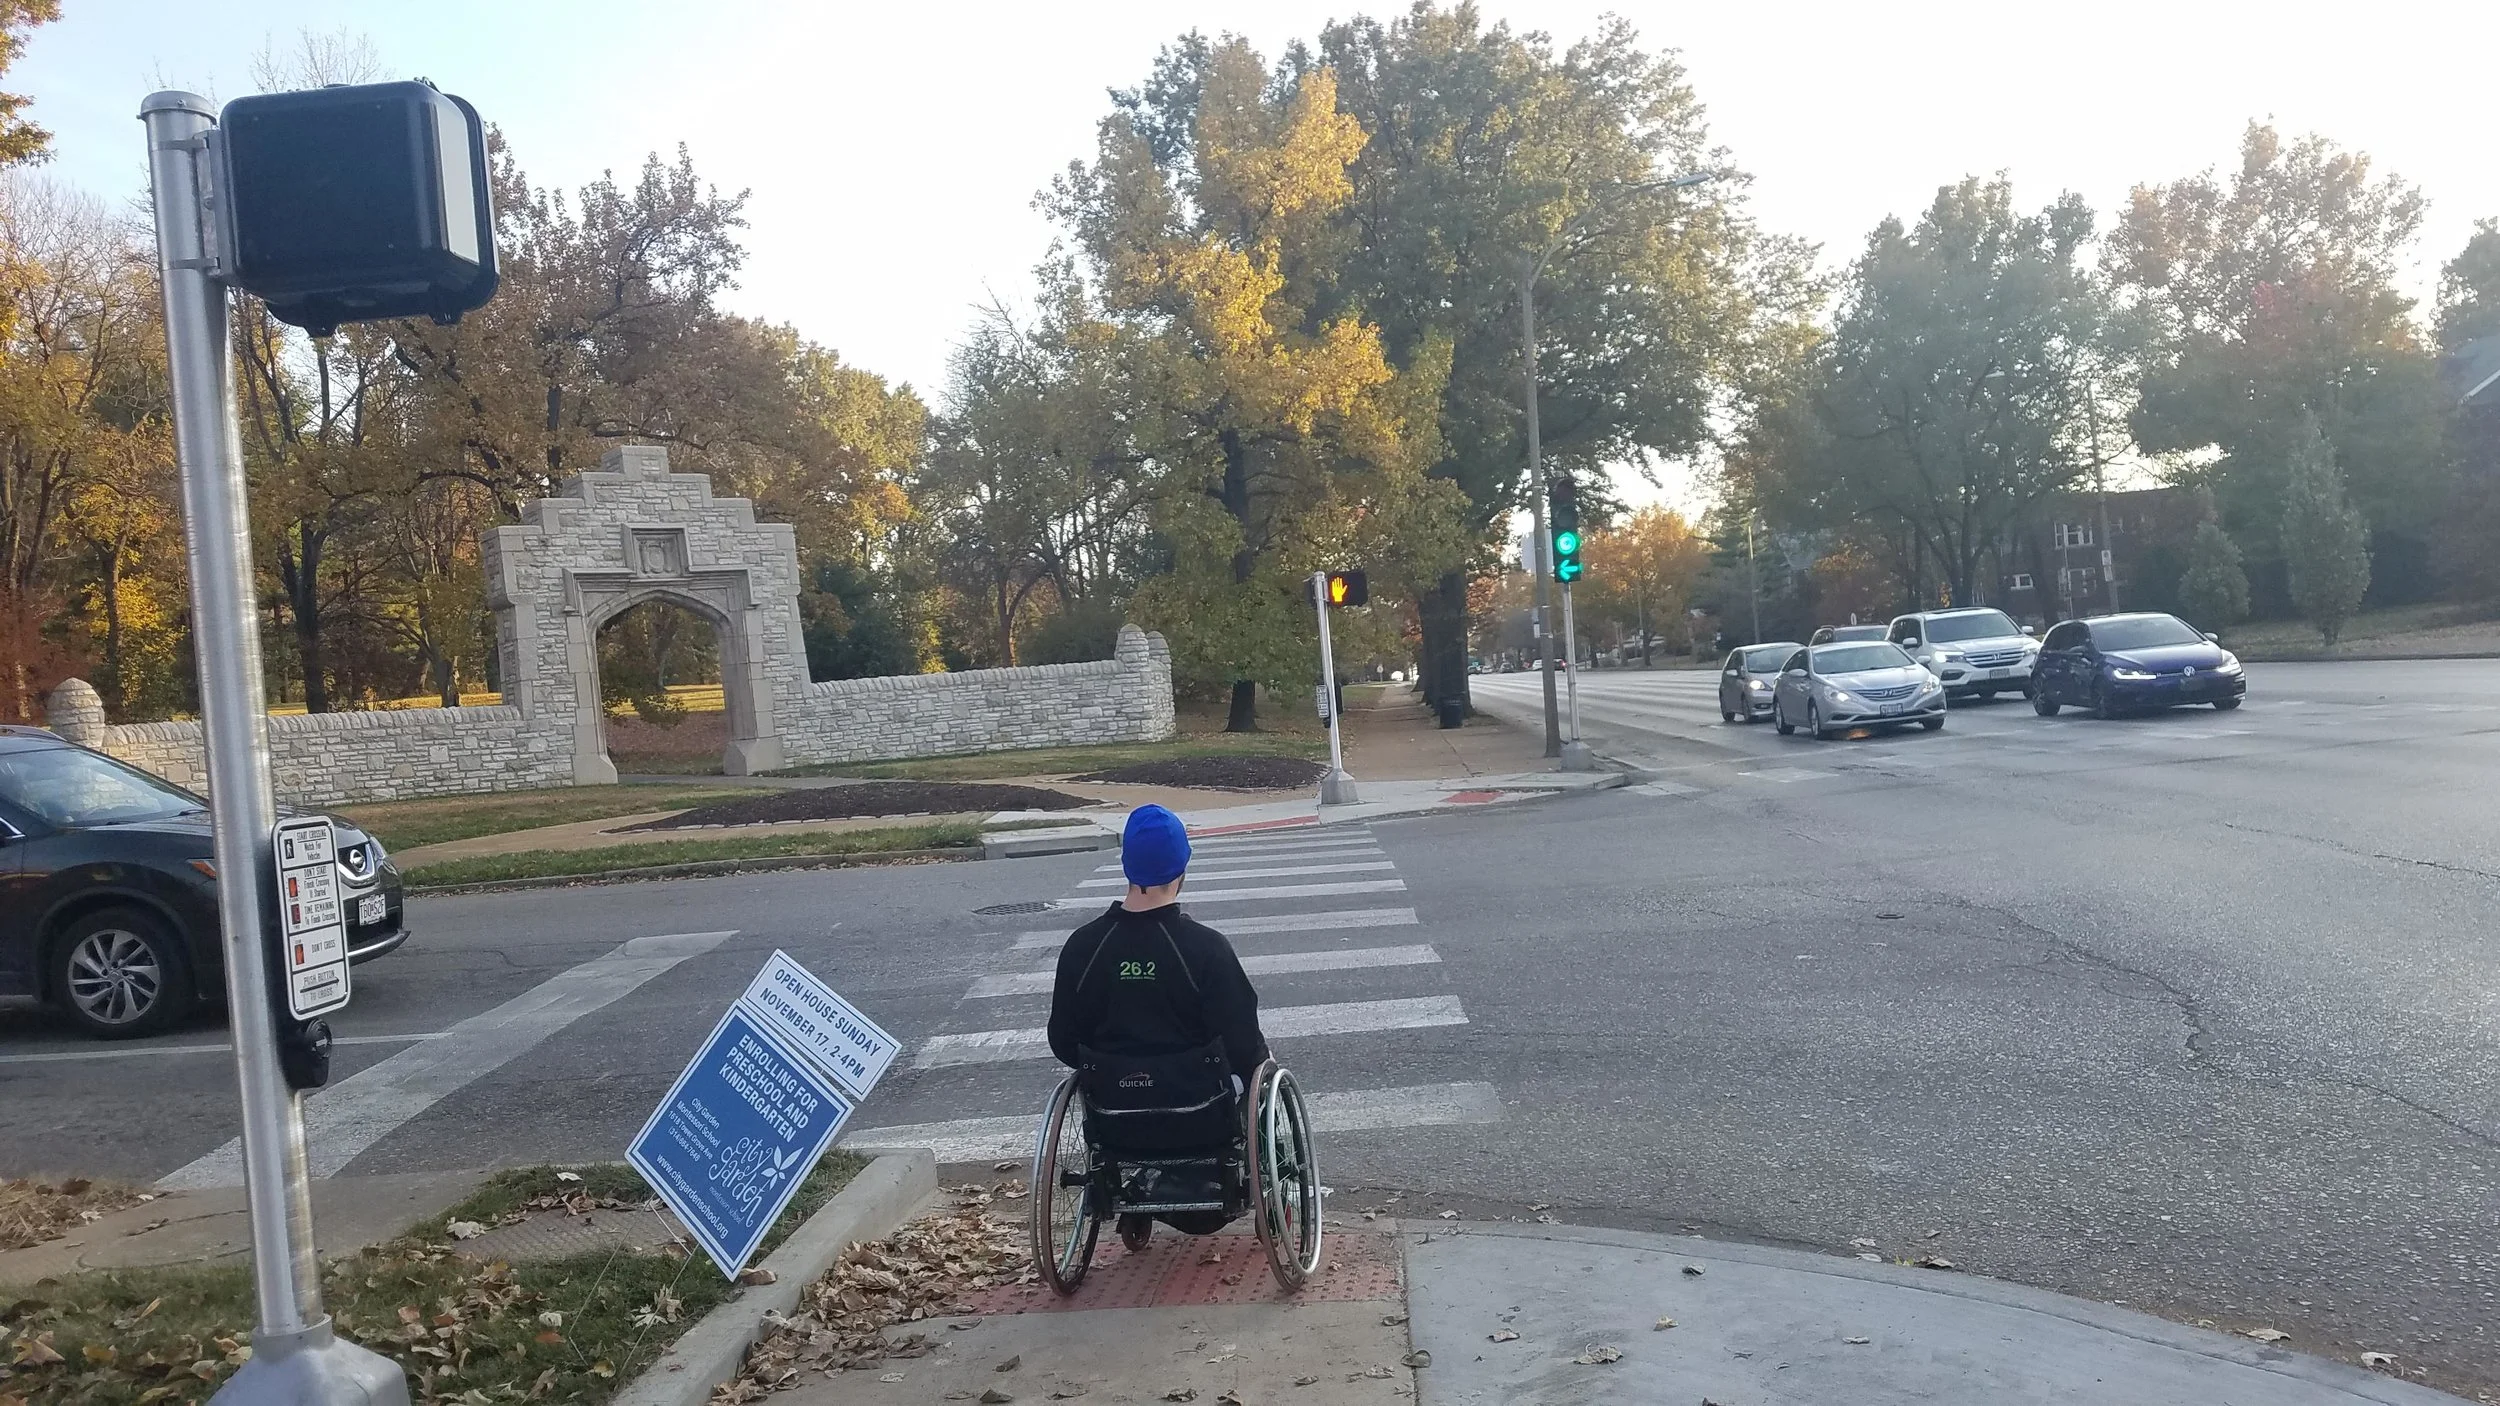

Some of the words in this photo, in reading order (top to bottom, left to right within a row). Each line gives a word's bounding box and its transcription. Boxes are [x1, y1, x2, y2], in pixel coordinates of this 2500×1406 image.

[296, 831, 308, 840] START
[309, 829, 327, 839] CROSSING
[304, 868, 315, 878] DON'T
[316, 866, 327, 875] START
[304, 880, 314, 889] Finish
[315, 879, 330, 887] Crossing
[304, 905, 313, 914] TIME
[314, 901, 334, 913] REMAINING
[311, 915, 320, 924] Finish
[322, 913, 336, 921] Crossing
[311, 942, 322, 953] DON'T
[324, 940, 336, 950] CROSS
[304, 974, 317, 986] PUSH
[318, 970, 335, 982] BUTTON
[1120, 961, 1156, 976] 26.2
[310, 992, 317, 1000] TO
[318, 988, 333, 998] CROSS
[774, 969, 804, 996] OPEN
[801, 989, 838, 1023] HOUSE
[835, 1017, 881, 1057] SUNDAY
[760, 987, 815, 1038] NOVEMBER
[814, 1032, 829, 1052] 17,
[830, 1045, 866, 1079] 2-4PM
[726, 1046, 786, 1108] PRESCHOOL
[784, 1102, 809, 1129] AND
[738, 1034, 797, 1093] ENROLLING
[794, 1086, 818, 1113] FOR
[1119, 1080, 1154, 1088] QUICKIE
[691, 1098, 703, 1112] City
[701, 1108, 720, 1129] Garden
[719, 1062, 797, 1142] KINDERGARTEN
[668, 1111, 680, 1125] 1618
[679, 1122, 693, 1138] Tower
[691, 1135, 705, 1151] Grove
[703, 1148, 713, 1160] Ave
[676, 1100, 705, 1131] Montessori
[702, 1126, 720, 1148] School
[736, 1137, 773, 1176] city
[656, 1154, 729, 1239] www.citygardenschool.org
[709, 1146, 766, 1227] garden
